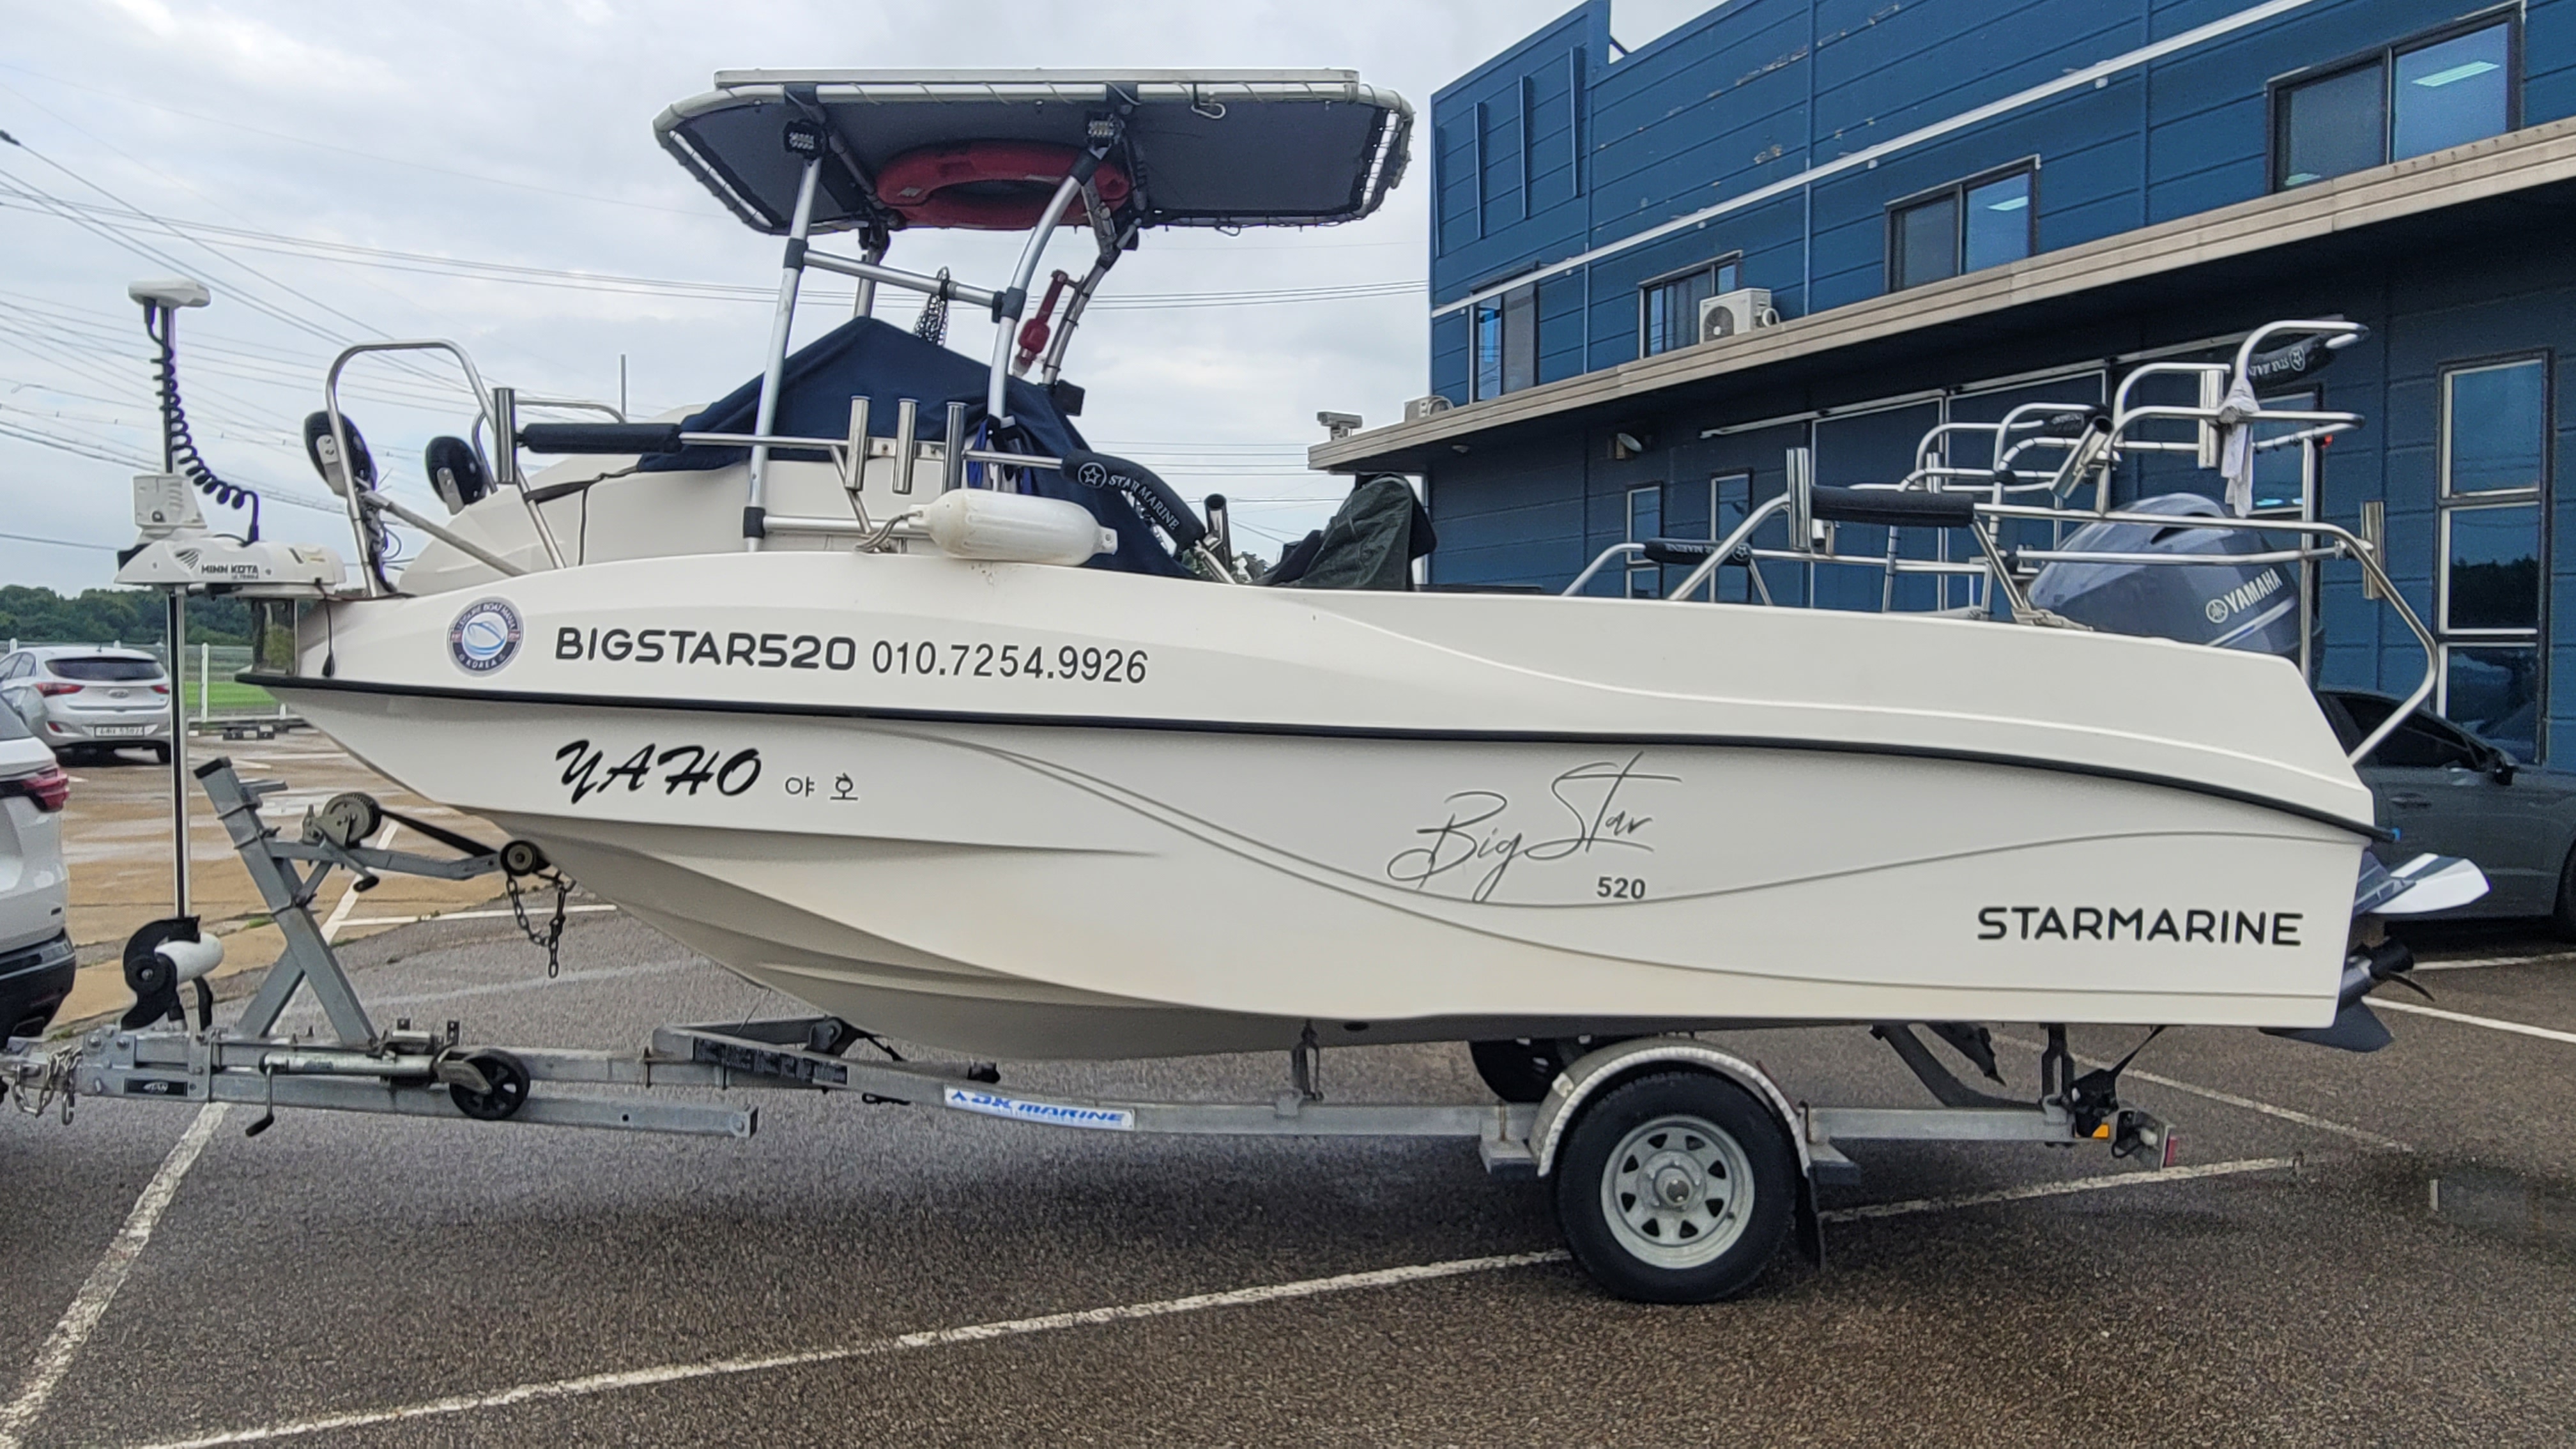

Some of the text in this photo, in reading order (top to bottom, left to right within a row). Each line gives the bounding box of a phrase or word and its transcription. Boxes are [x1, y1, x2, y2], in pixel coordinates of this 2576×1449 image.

[201, 565, 259, 574] MINN KOTA
[2223, 567, 2283, 613] YAMAHA
[465, 659, 498, 669] KOREA
[556, 627, 1149, 684] BIGSTAR520 010.7254.9926
[555, 739, 762, 805] YAHO
[1386, 750, 1683, 904] Big Star
[1597, 876, 1646, 900] 520
[1977, 906, 2304, 946] STARMARINE
[1018, 1104, 1124, 1121] MARINE
